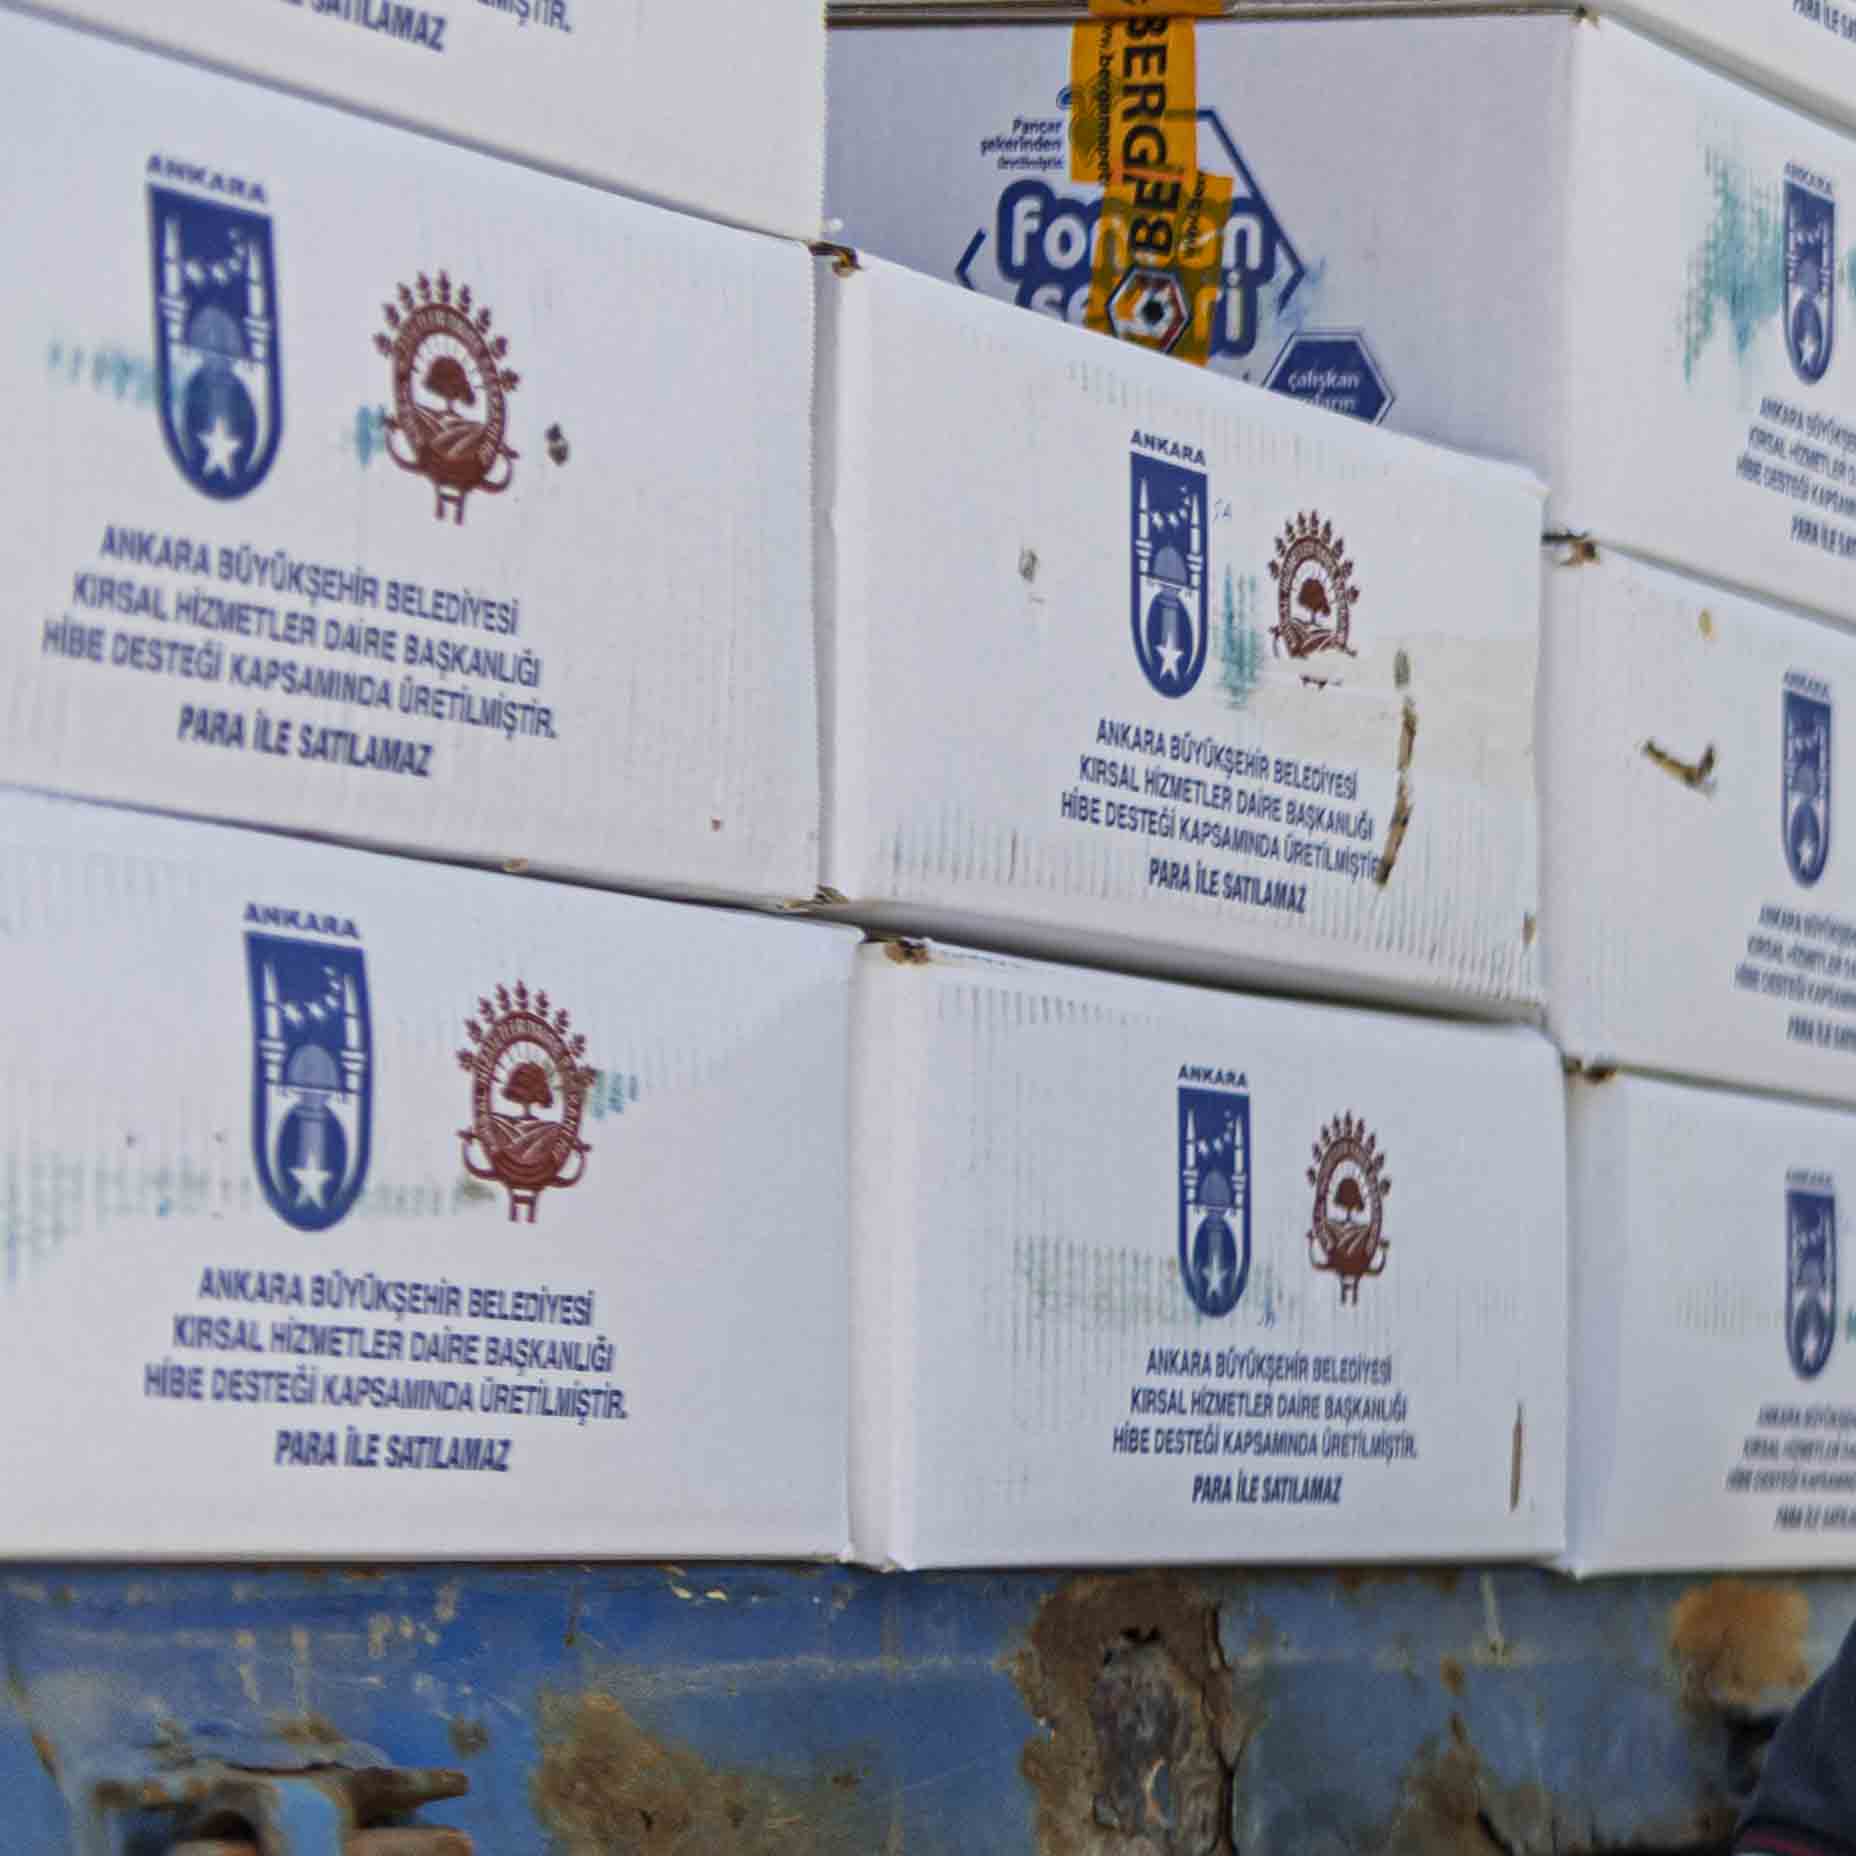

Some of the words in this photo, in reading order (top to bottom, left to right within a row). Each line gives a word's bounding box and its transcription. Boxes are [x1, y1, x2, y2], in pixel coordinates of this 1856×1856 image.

[1122, 16, 1169, 182] BERG
[146, 153, 266, 200] ANKARA
[99, 524, 211, 575] ANKARA
[217, 544, 380, 608] BÜYÜKŞEHİR
[385, 579, 518, 635] BELEDİYESİ
[72, 572, 168, 622] KIRSAL
[174, 587, 318, 645] HİZMETLER
[323, 618, 398, 663] DAİRE
[402, 632, 541, 688] BAŞKANLIĞI
[41, 615, 105, 663] HİBE
[111, 631, 222, 681] DESTEĞİ
[228, 653, 392, 710] KAPSAMINDA
[177, 704, 246, 748] PARA
[252, 710, 292, 756] İLE
[297, 723, 434, 778] SATILAMAZ
[243, 902, 360, 938] ANKARA
[198, 1267, 304, 1305] ANKARA
[310, 1268, 462, 1320] BÜYÜKŞEHİR
[467, 1284, 594, 1326] BELEDİYESİ
[173, 1315, 264, 1353] KIRSAL
[270, 1317, 405, 1360] HİZMETLER
[409, 1325, 481, 1366] DAİRE
[484, 1334, 615, 1376] BAŞKANLIĞI
[143, 1363, 204, 1400] HİBE
[211, 1366, 317, 1404] DESTEĞİ
[321, 1374, 475, 1412] KAPSAMINDA
[274, 1429, 338, 1466] PARA
[343, 1432, 381, 1467] İLE
[383, 1433, 512, 1472] SATILAMAZ
